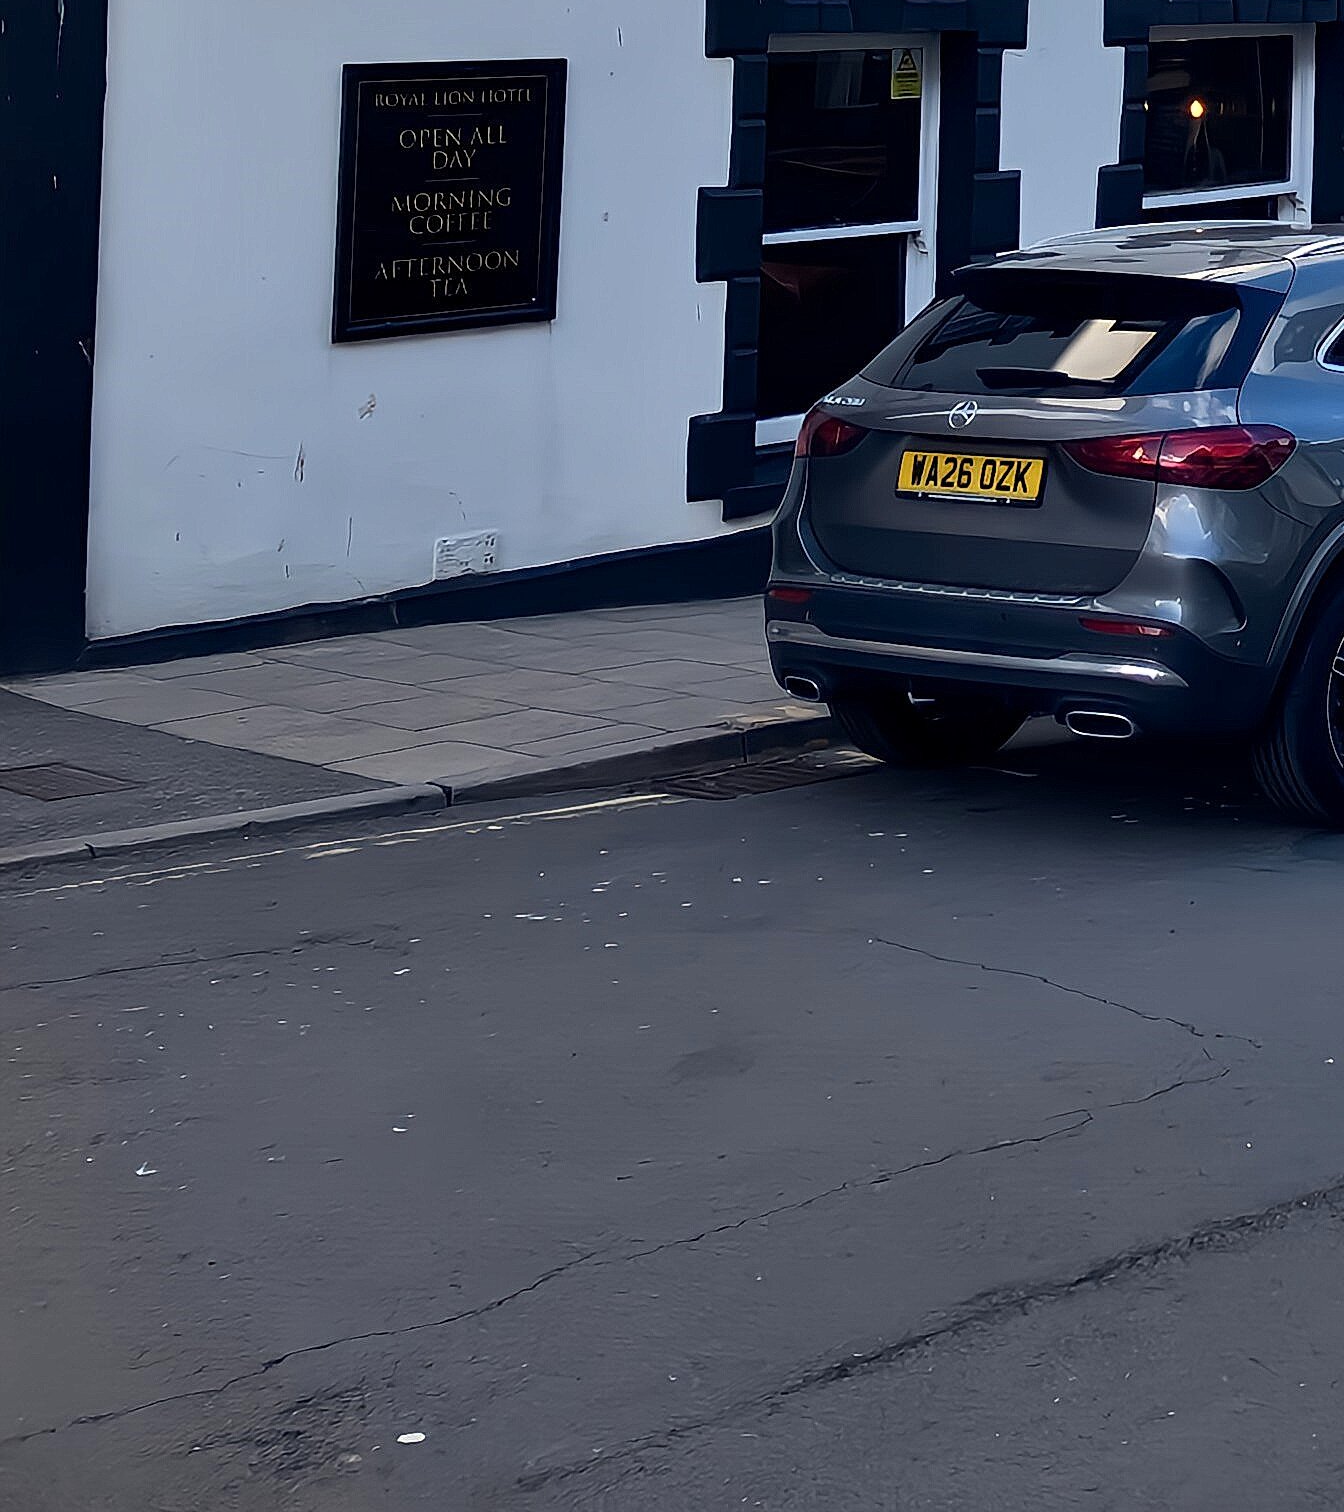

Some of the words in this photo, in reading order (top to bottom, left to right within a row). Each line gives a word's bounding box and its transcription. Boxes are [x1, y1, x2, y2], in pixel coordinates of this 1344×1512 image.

[375, 92, 426, 108] ROYAL
[434, 89, 475, 106] LION
[481, 88, 532, 104] HOTEL
[399, 128, 461, 149] OPEN
[470, 125, 507, 145] ALL
[432, 149, 476, 170] DAY
[391, 188, 512, 213] MORNING
[409, 211, 493, 235] COFFEE
[374, 249, 520, 280] AFTERNOON
[430, 277, 468, 298] TEA
[910, 454, 974, 489] WA26
[979, 458, 1033, 494] OZK
